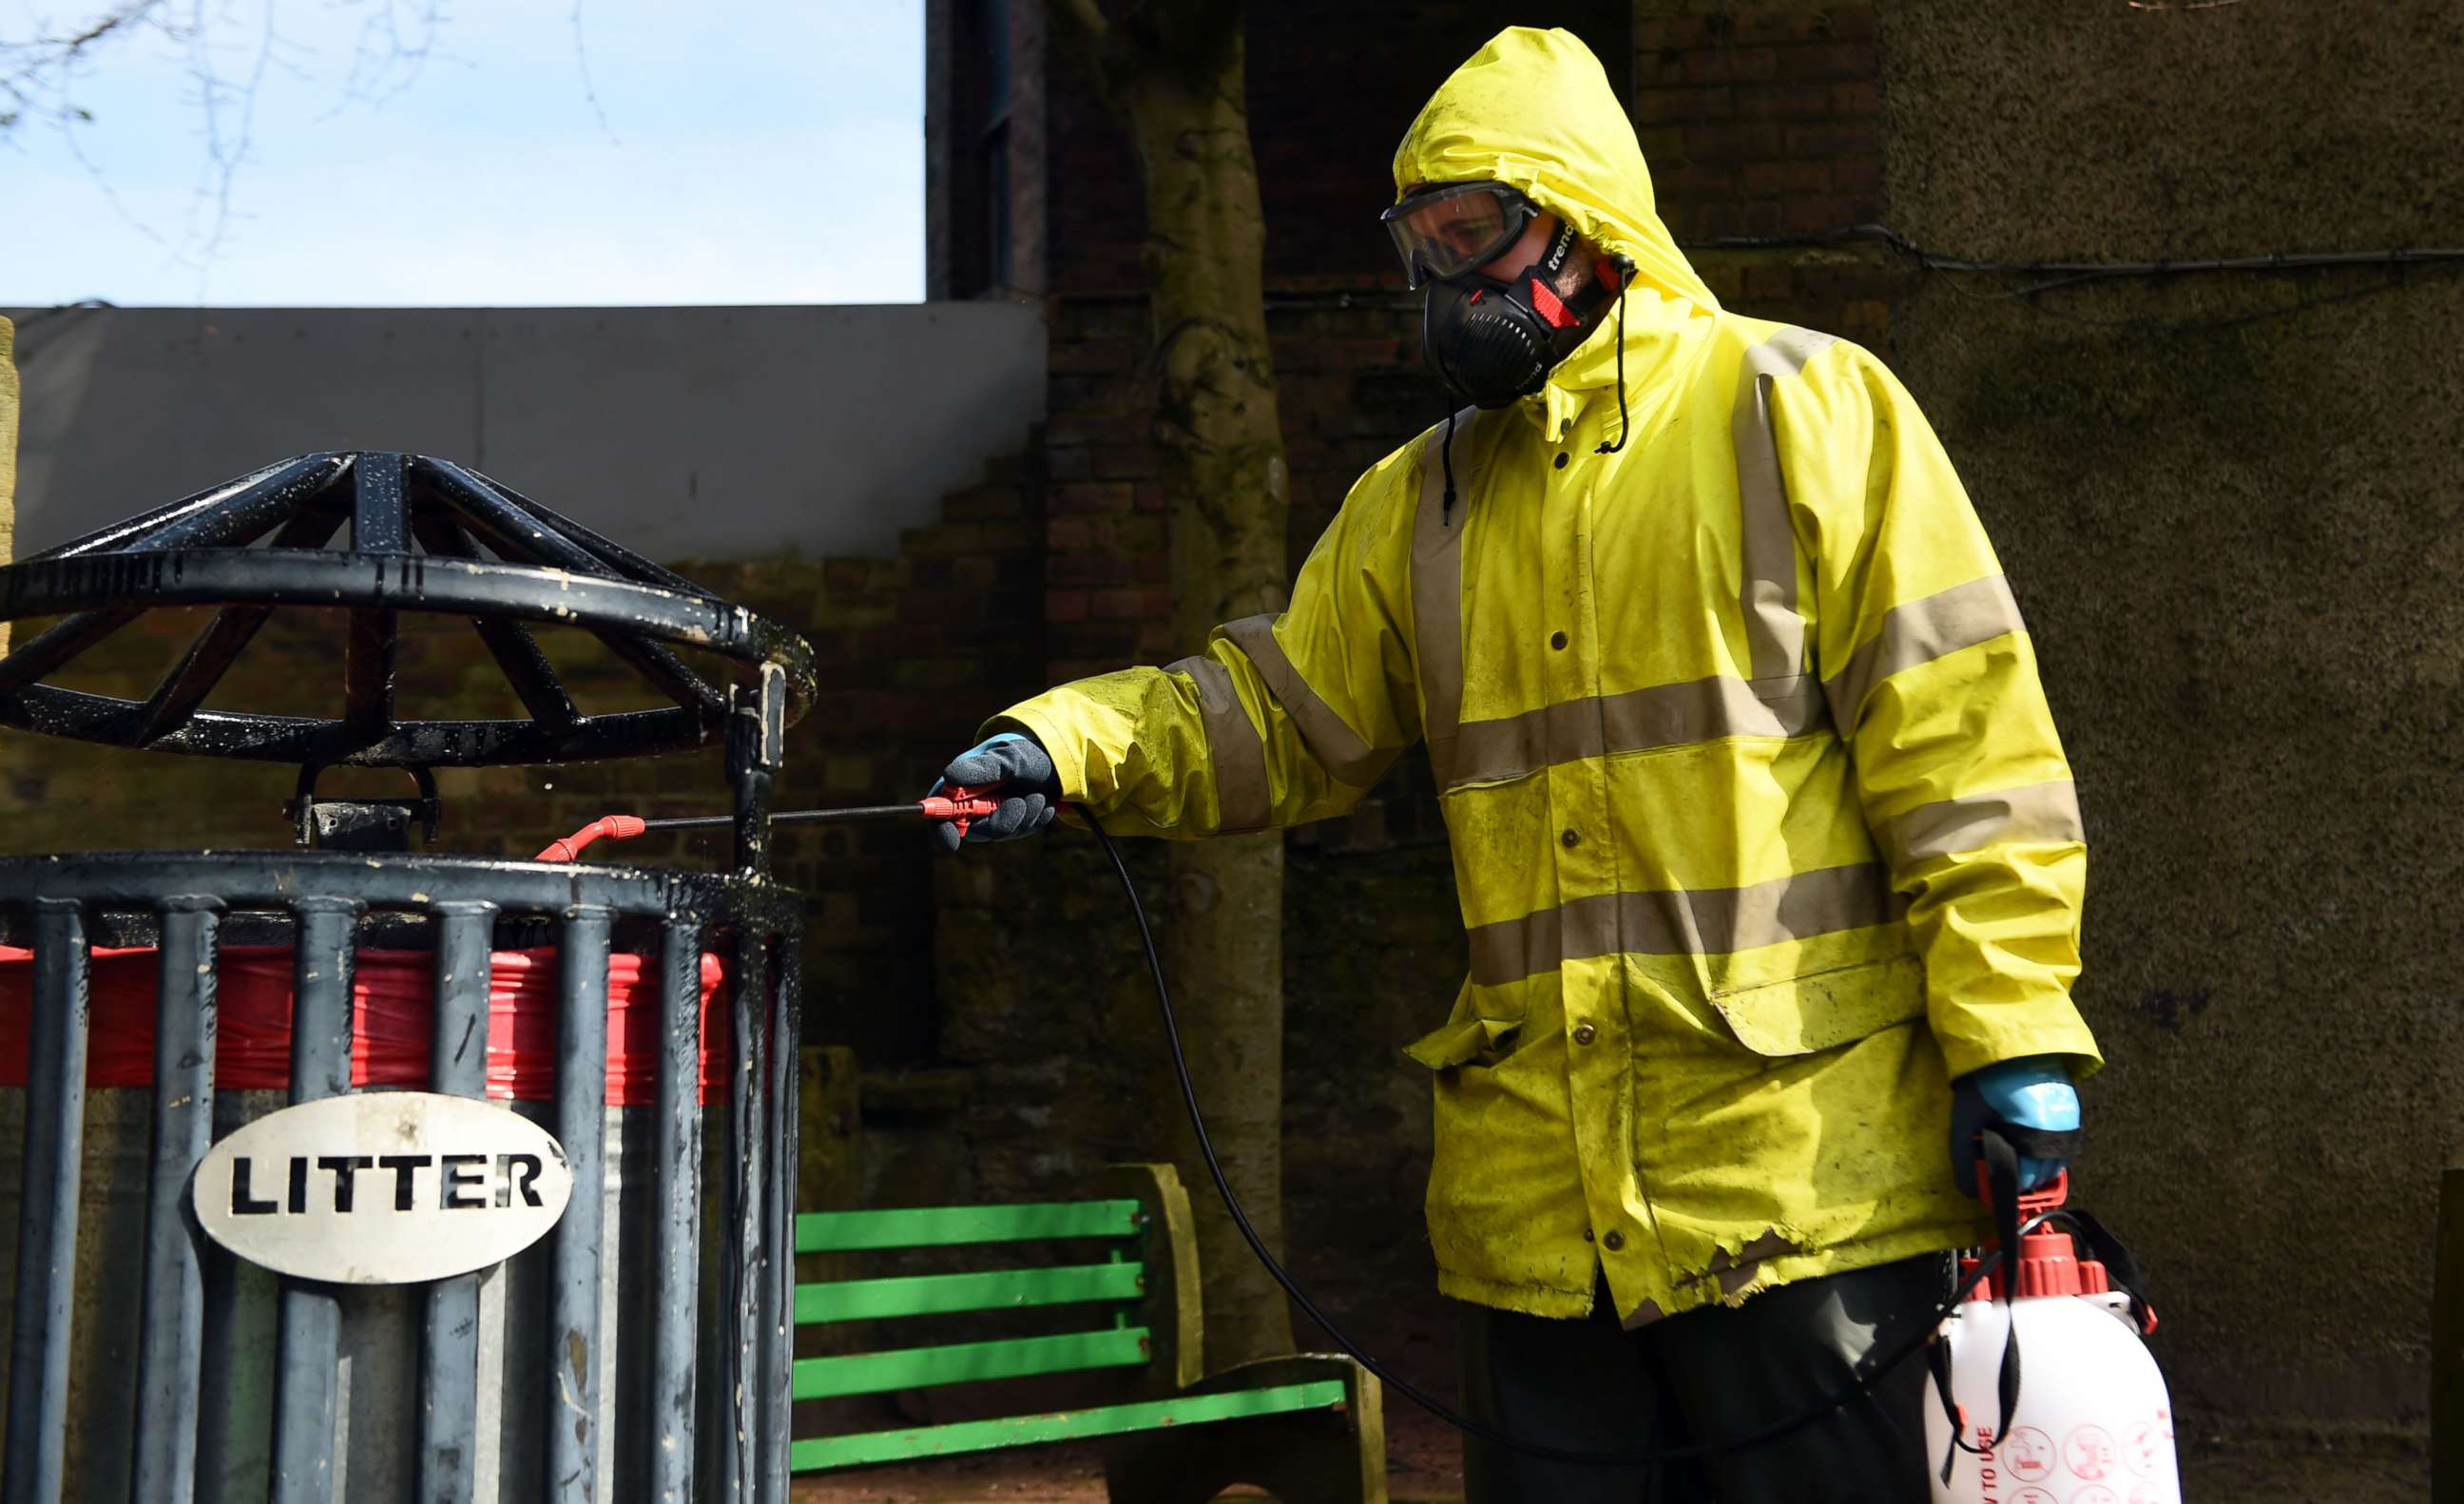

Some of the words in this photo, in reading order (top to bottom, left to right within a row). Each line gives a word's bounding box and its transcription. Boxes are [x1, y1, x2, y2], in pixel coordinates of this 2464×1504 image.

[231, 1153, 544, 1215] LITTER
[1977, 1427, 1995, 1462] USE
[1981, 1468, 1997, 1492] TO
